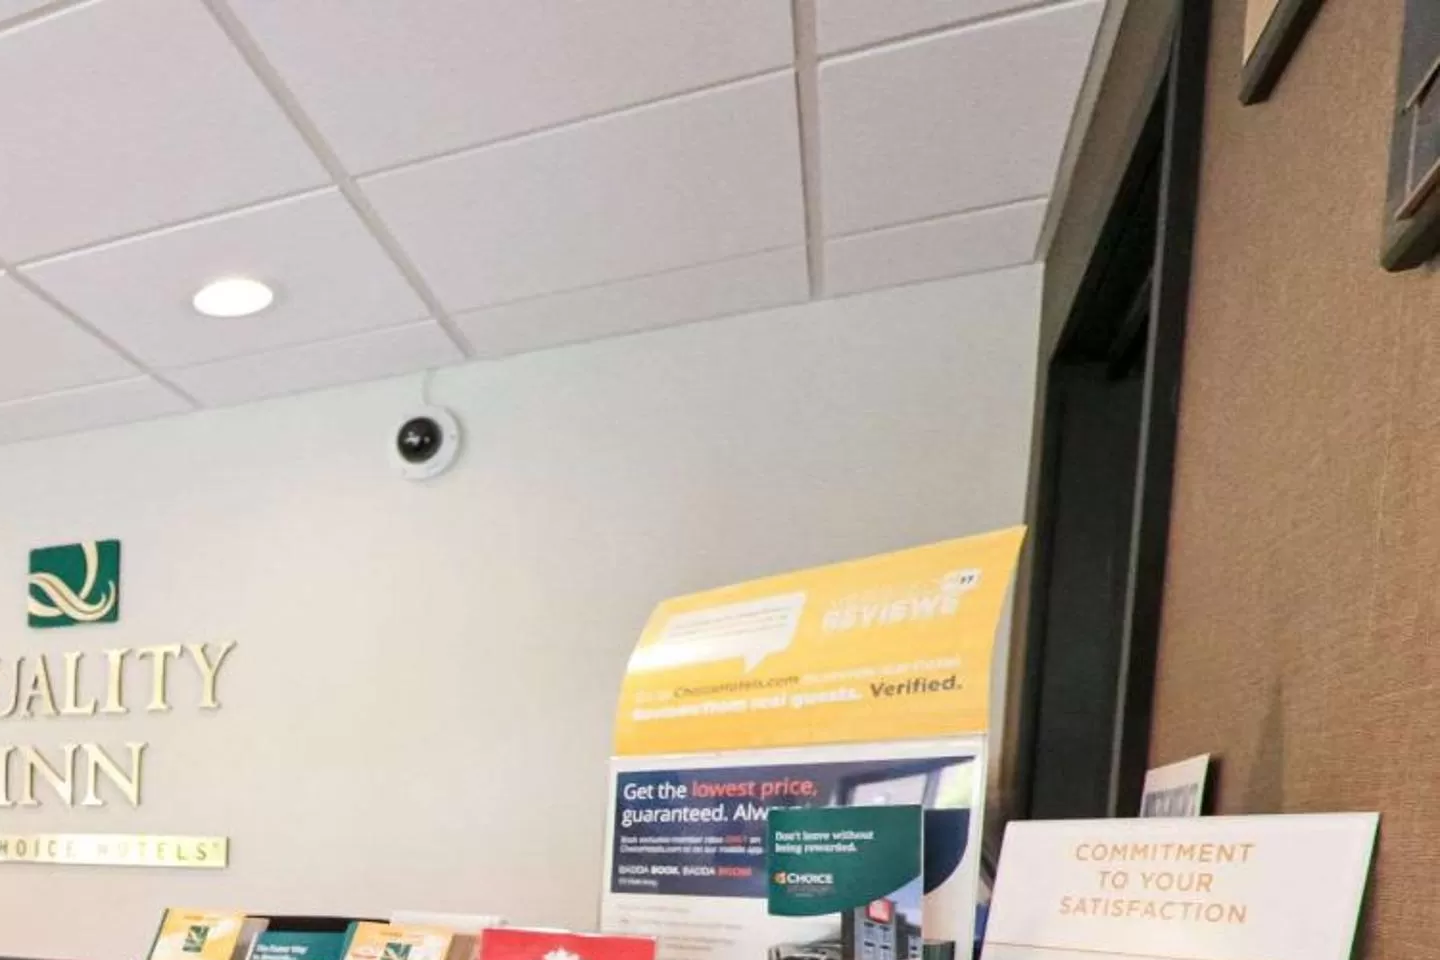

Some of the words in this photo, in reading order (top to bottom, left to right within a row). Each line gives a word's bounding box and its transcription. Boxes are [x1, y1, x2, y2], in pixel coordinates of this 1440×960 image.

[869, 675, 964, 699] Verified.
[622, 782, 654, 801] Get
[658, 781, 687, 799] the
[692, 779, 756, 798] lowest
[620, 803, 729, 828] guaranteed.
[1075, 843, 1256, 863] COMMITMENT
[1099, 870, 1129, 890] TO
[1141, 871, 1215, 893] YOUR
[1059, 895, 1248, 924] SATISFACTION
